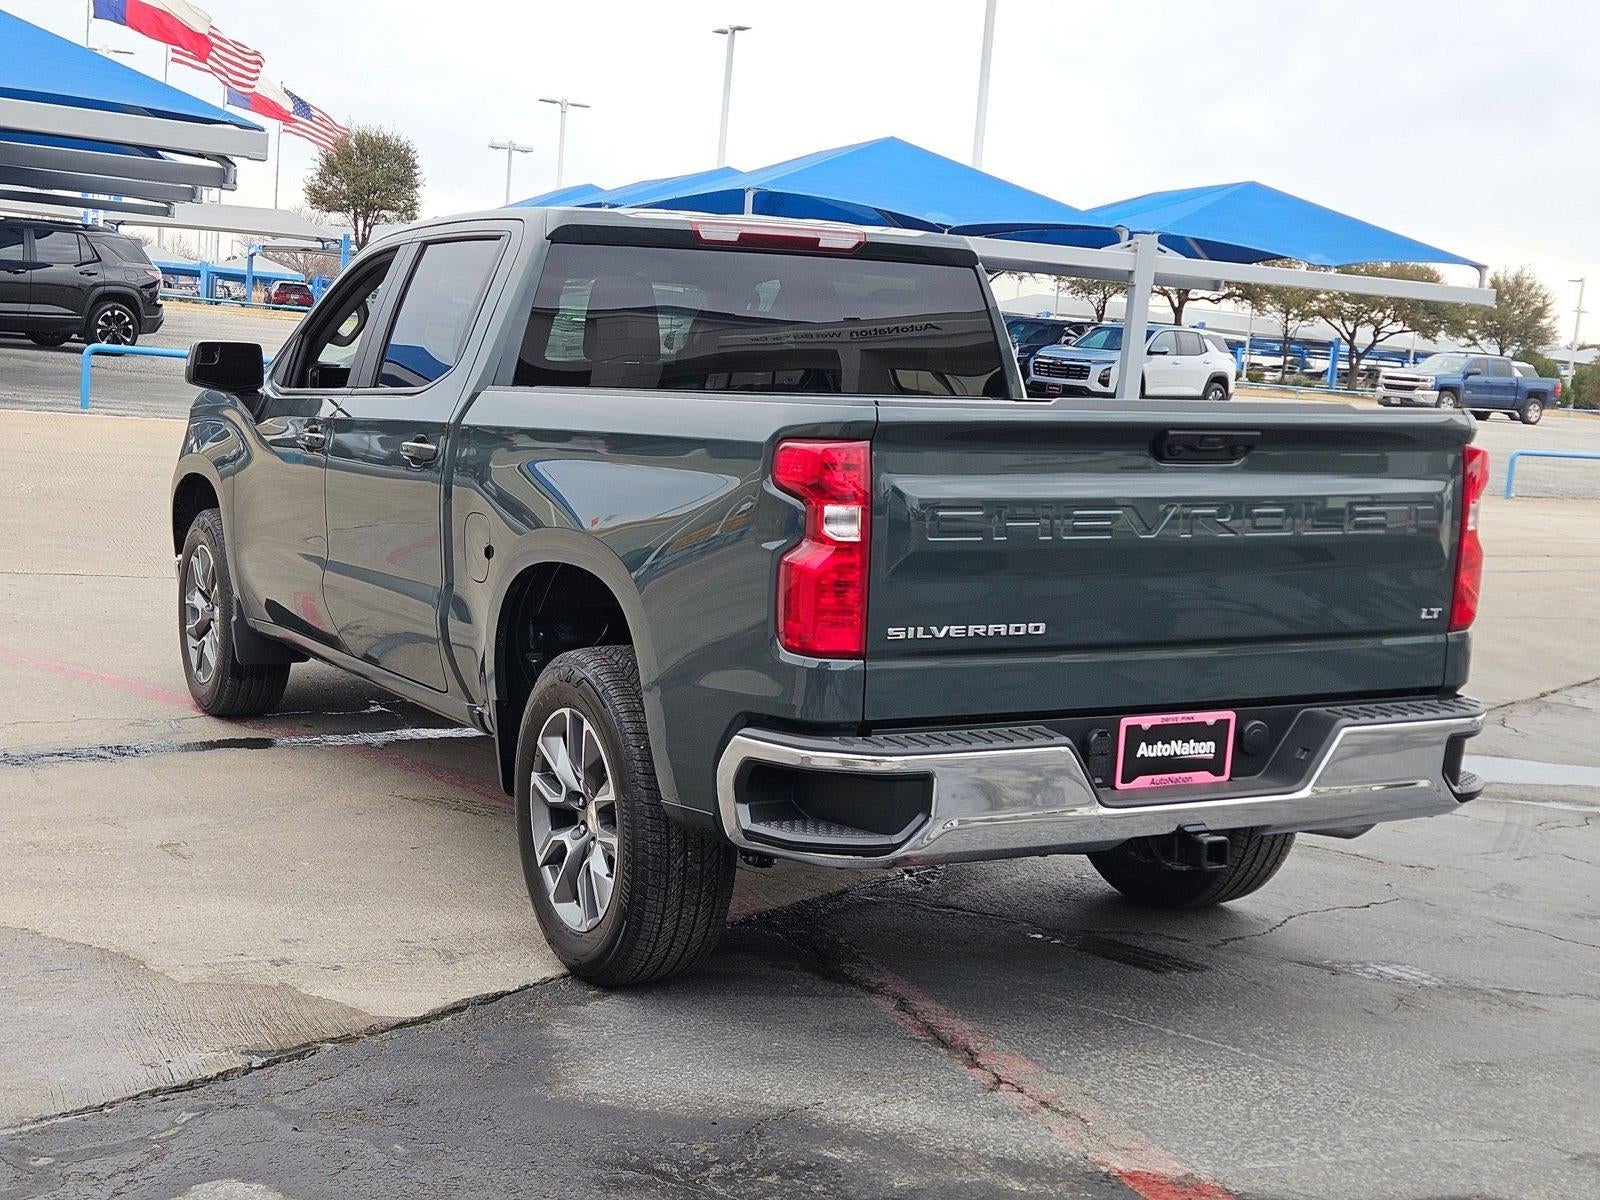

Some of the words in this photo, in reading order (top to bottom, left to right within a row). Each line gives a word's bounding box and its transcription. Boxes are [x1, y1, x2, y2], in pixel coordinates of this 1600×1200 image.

[925, 500, 1436, 541] CHEVROLET
[1421, 607, 1443, 619] LT
[886, 622, 1047, 640] SILVERADO
[1136, 739, 1216, 758] AutoNation
[1149, 775, 1193, 786] AutoNation
